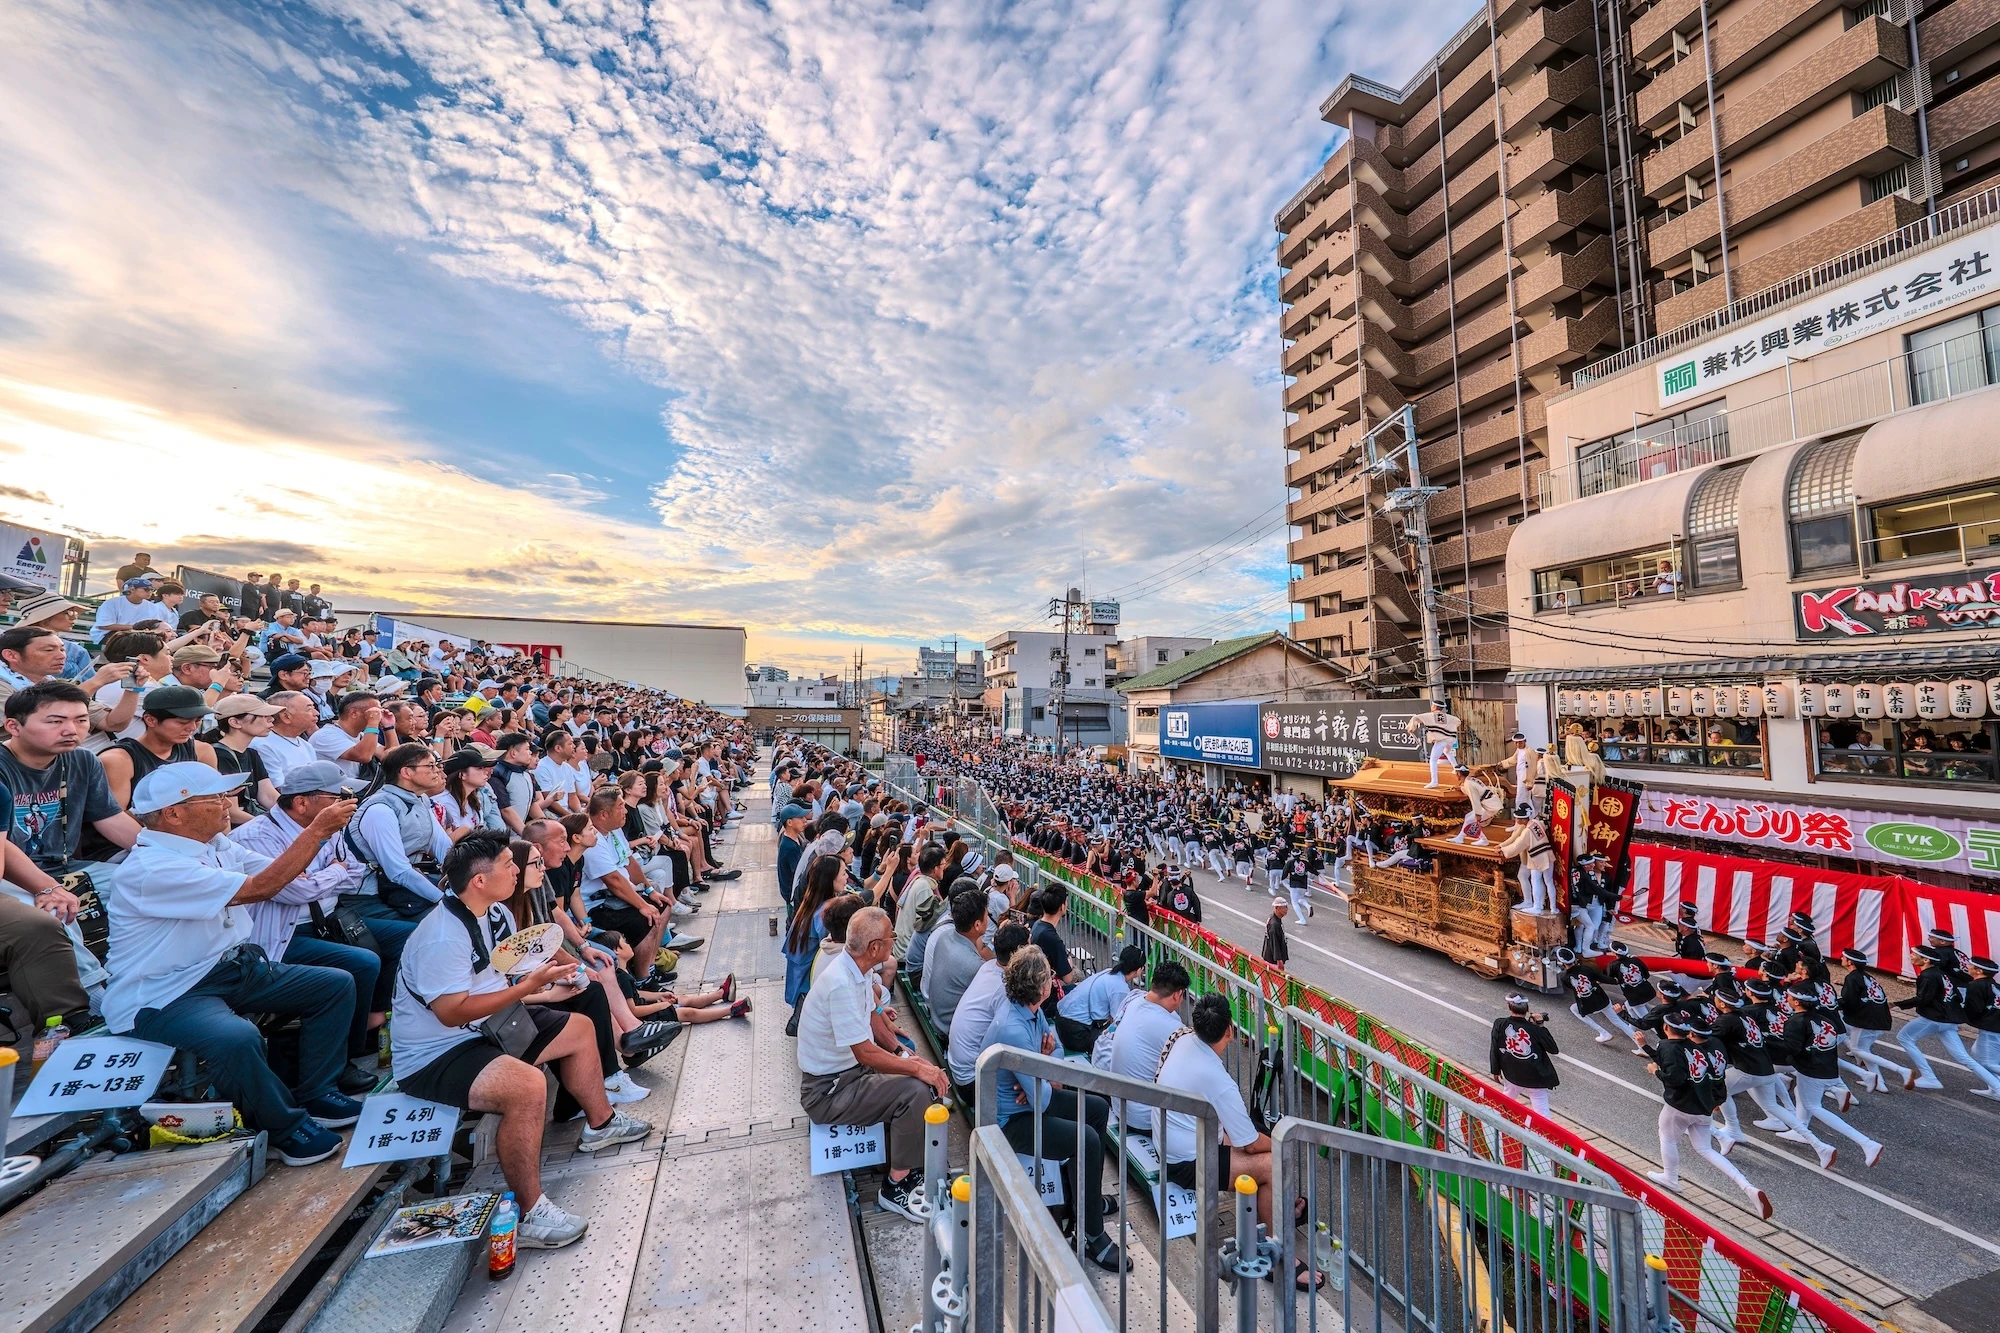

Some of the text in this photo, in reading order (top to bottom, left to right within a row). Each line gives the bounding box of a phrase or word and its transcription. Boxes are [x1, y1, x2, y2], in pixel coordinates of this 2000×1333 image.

[1703, 250, 1992, 378] 兼杉興業株式会社
[16, 560, 46, 571] Energy
[1590, 694, 1598, 713] 北町
[1670, 691, 1680, 712] 上町
[1765, 688, 1778, 713] 大工町
[1800, 687, 1814, 712] 大手町
[1857, 688, 1871, 714] 南町
[1920, 685, 1935, 714] 中北町
[775, 713, 842, 723] コープの保険相談
[1283, 714, 1311, 724] オリジナル
[1283, 726, 1311, 739] 専門店
[1269, 756, 1283, 766] TEL
[1665, 797, 1854, 851] だんじり祭
[1892, 832, 1933, 846] TVK
[1507, 1029, 1531, 1053] 大北
[1815, 1021, 1837, 1046] 大北
[73, 1051, 143, 1071] B 5列
[382, 1106, 436, 1125] S 4列
[830, 1124, 866, 1138] S 3列
[1168, 1194, 1177, 1207] S
